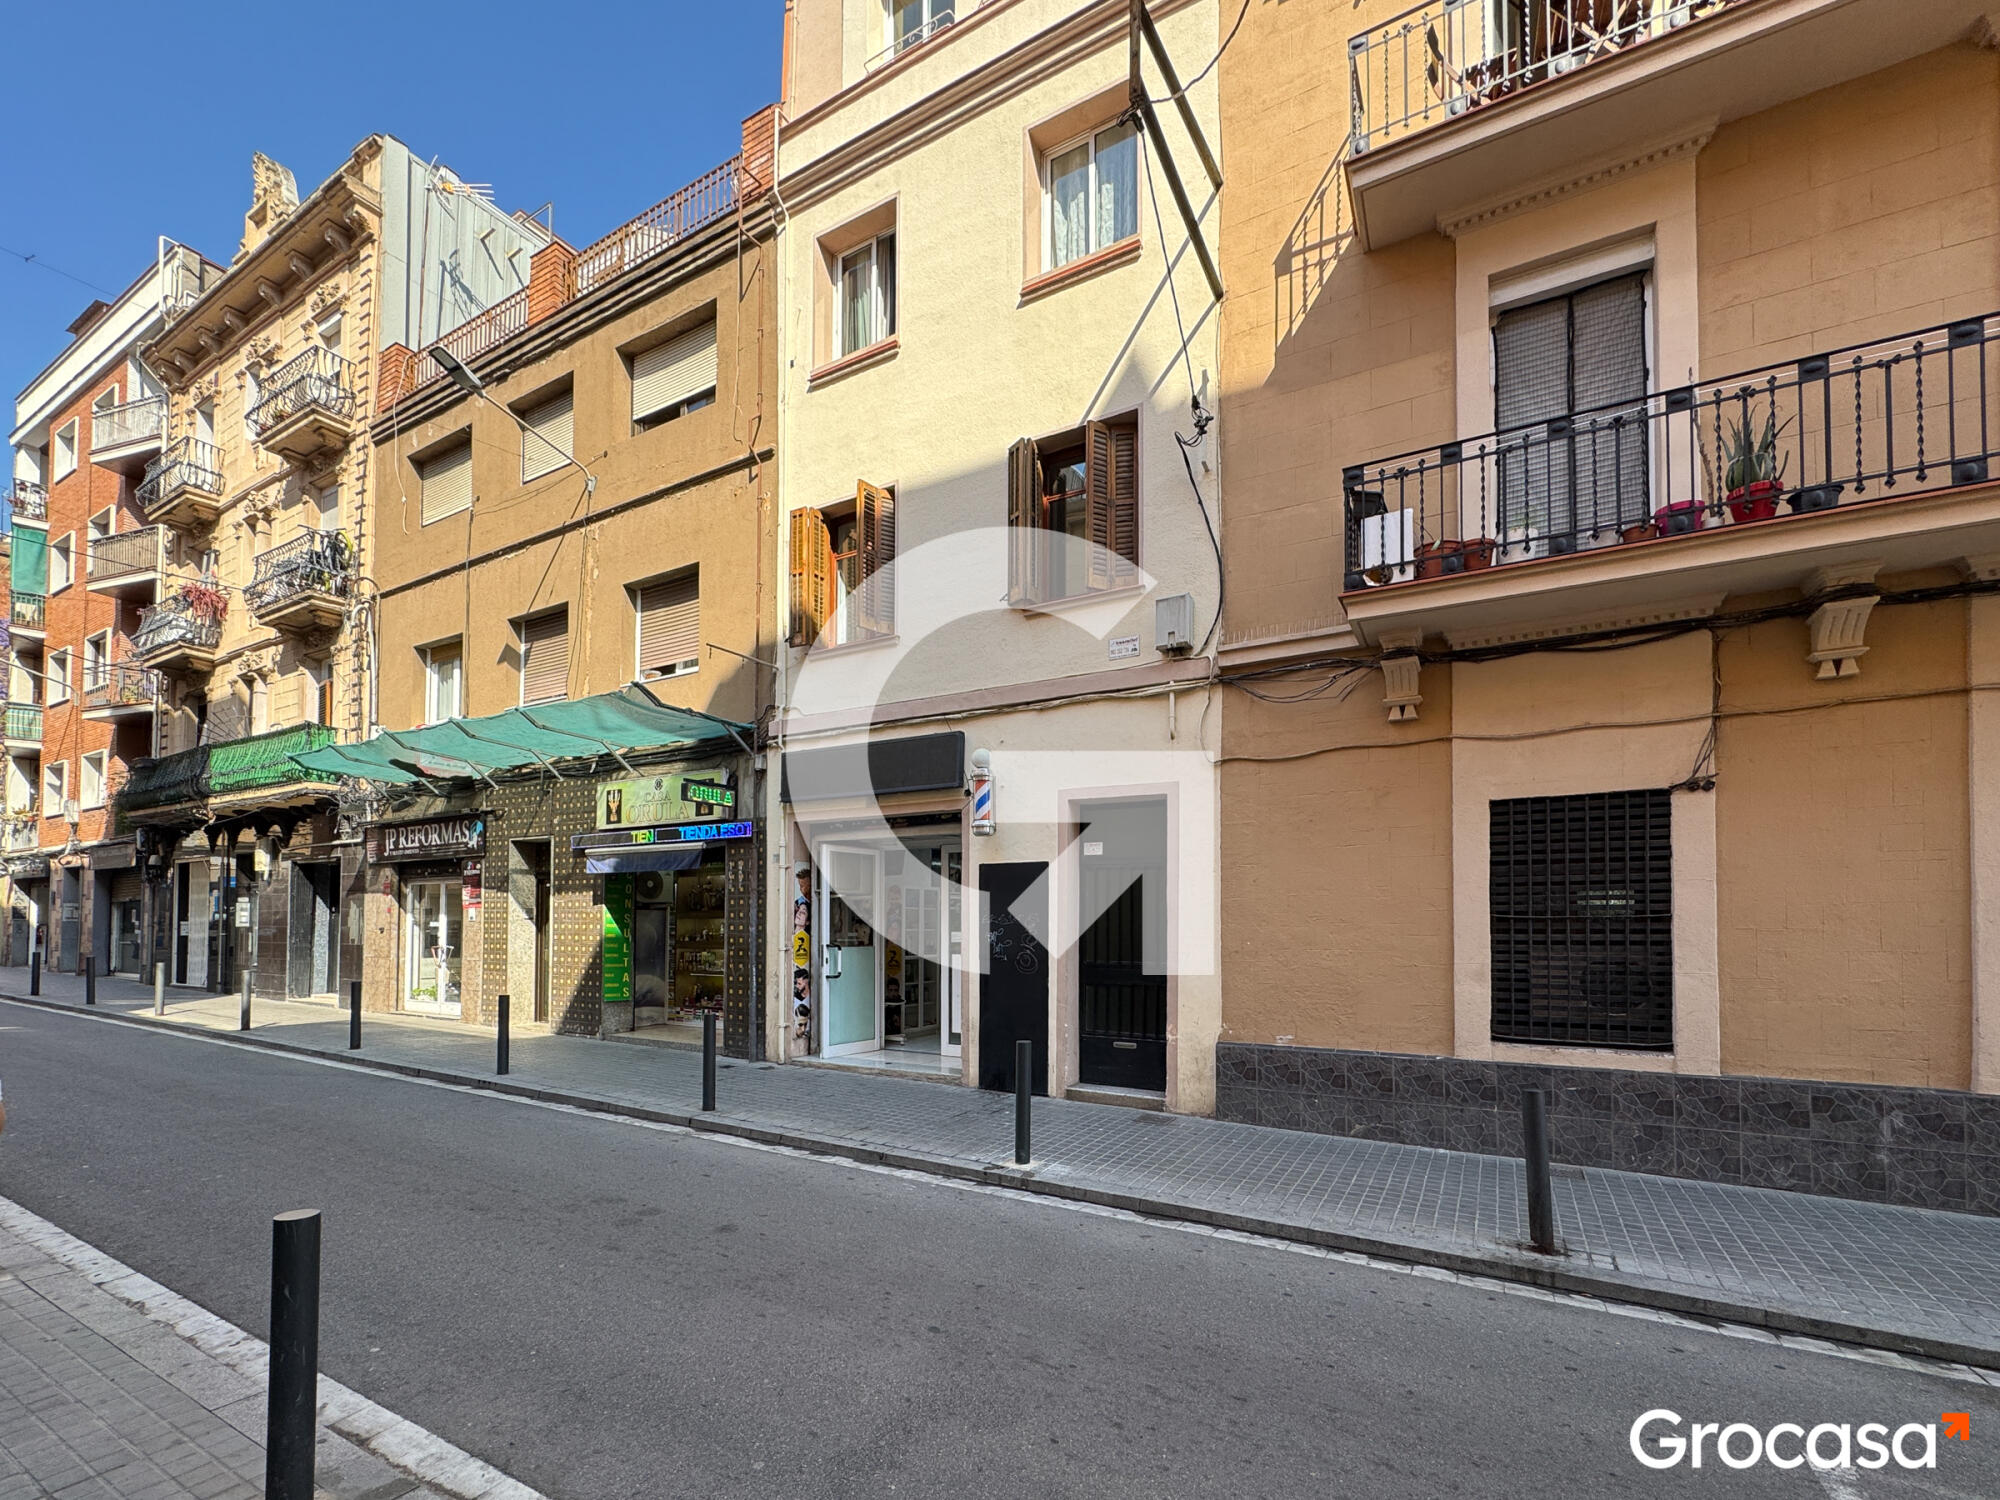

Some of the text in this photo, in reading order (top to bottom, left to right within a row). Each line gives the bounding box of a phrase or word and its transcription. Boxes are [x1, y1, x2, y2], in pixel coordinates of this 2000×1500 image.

[643, 790, 671, 802] CASA
[625, 801, 690, 824] ORULA
[384, 829, 397, 856] JP
[399, 820, 469, 848] REFORMAS
[631, 829, 654, 843] TIEN
[679, 825, 719, 841] TIENDA
